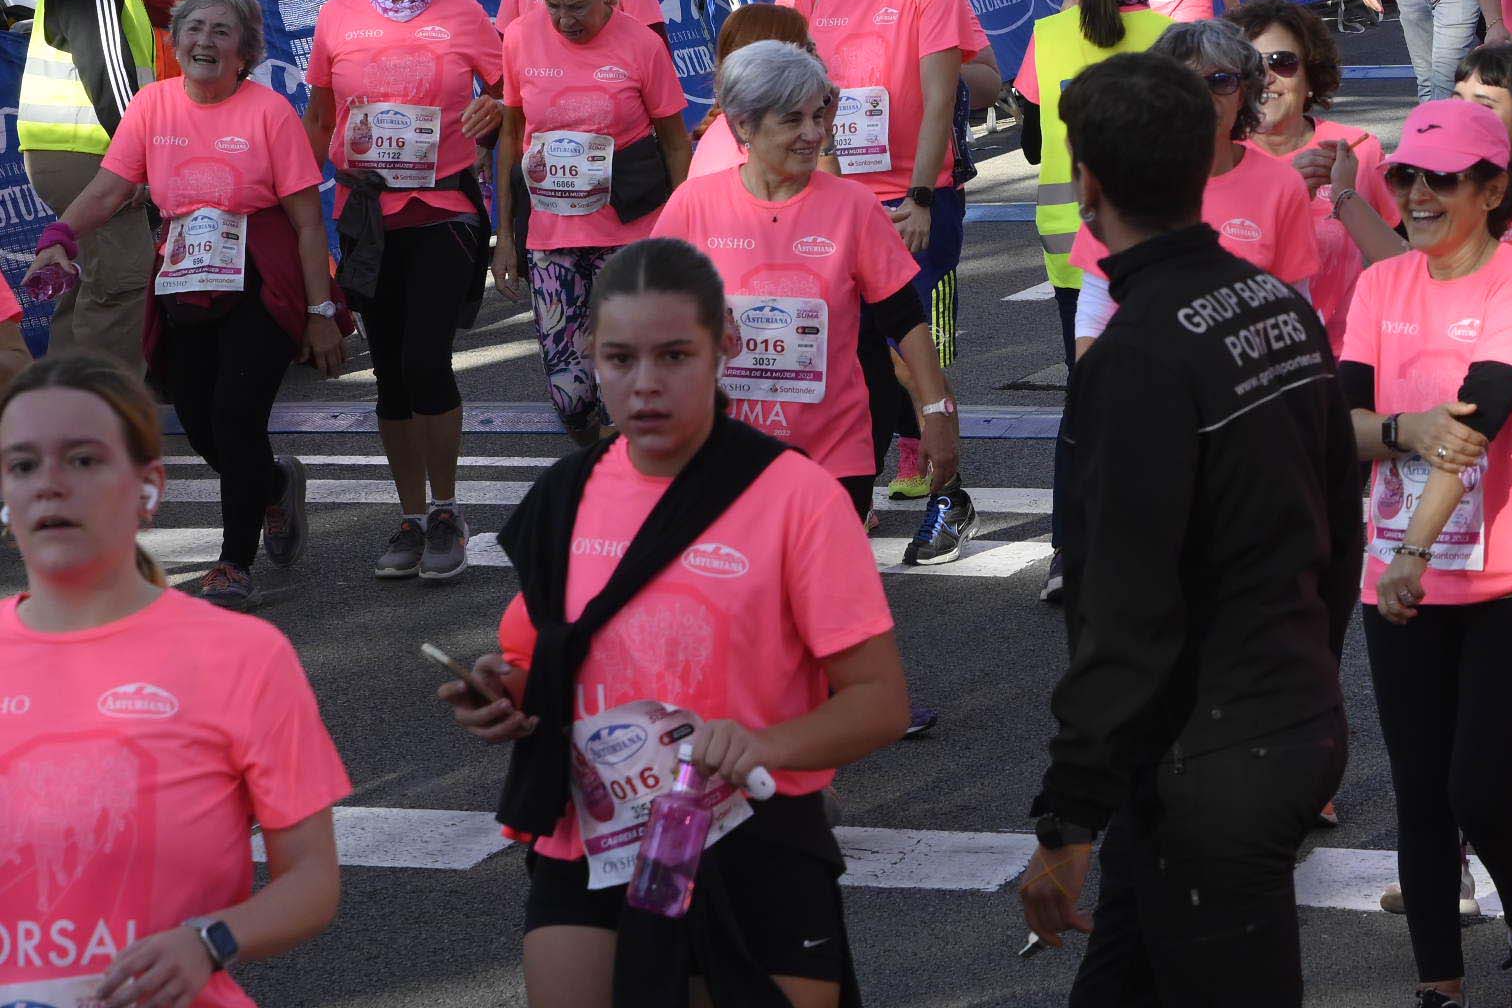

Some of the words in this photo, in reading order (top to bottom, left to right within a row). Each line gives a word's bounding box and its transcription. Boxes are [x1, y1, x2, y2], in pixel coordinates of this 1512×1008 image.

[815, 17, 849, 27] OYSHO
[524, 67, 564, 78] OYSHO
[375, 116, 409, 126] ASTURIANA
[153, 135, 189, 147] OYSHO
[375, 135, 406, 148] 016
[378, 151, 401, 160] 17122
[855, 159, 883, 167] Santander
[549, 164, 579, 177] 016
[187, 240, 212, 256] 016
[707, 237, 756, 250] OYSHO
[1177, 287, 1241, 334] GRUP
[744, 313, 789, 326] ASTURIANA
[745, 337, 785, 354] 016
[752, 356, 777, 367] 3037
[751, 370, 762, 378] DE
[762, 370, 772, 378] LA
[779, 385, 816, 395] Santander
[684, 554, 746, 574] ASTURIANA
[610, 765, 661, 801] 016
